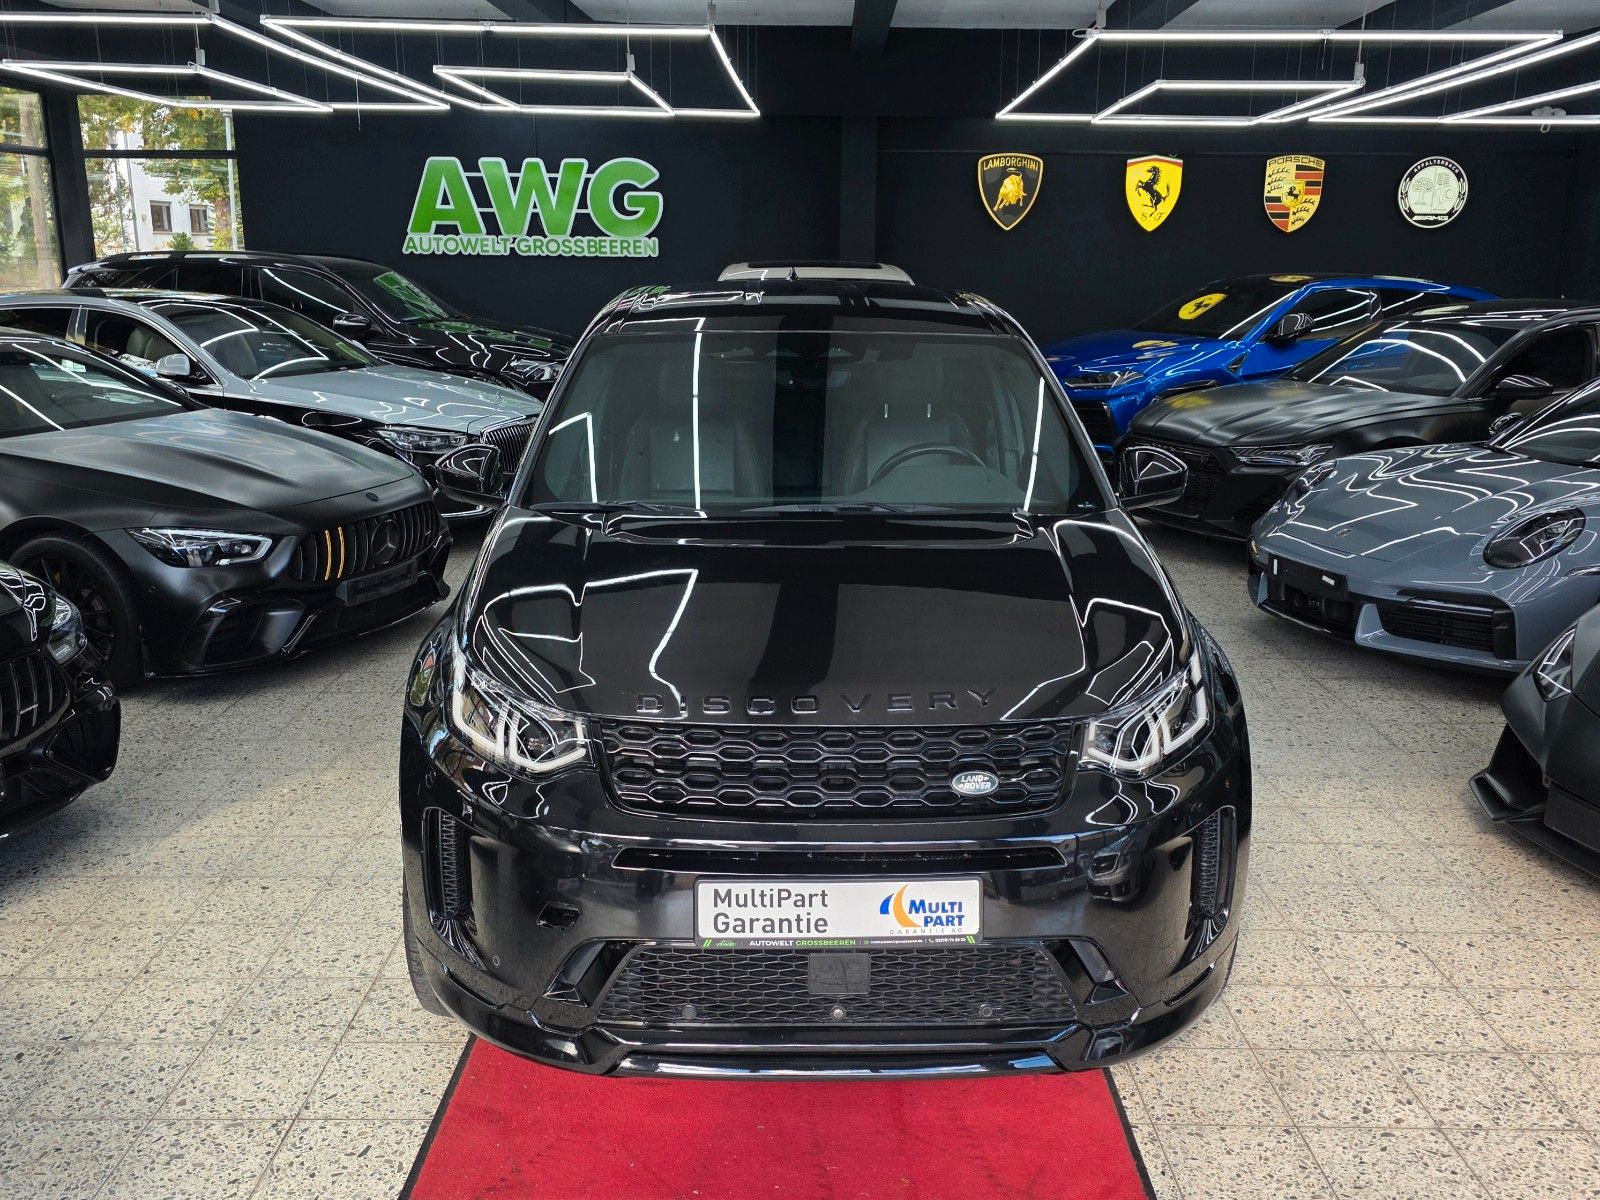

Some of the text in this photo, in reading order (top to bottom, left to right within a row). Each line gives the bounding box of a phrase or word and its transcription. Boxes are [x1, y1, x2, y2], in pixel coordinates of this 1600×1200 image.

[983, 157, 1039, 171] LAMBORGHINI
[1268, 156, 1323, 168] PORSCHE
[407, 156, 664, 238] AWG
[515, 235, 659, 257] GROSSBEEREN
[636, 691, 997, 714] DISCOVERY
[960, 774, 984, 783] LAND
[963, 781, 992, 790] ROVER
[713, 888, 829, 908] MultiPart
[713, 912, 829, 934] Garantie
[923, 914, 965, 927] PART
[795, 938, 856, 947] GROSSBEEREN
